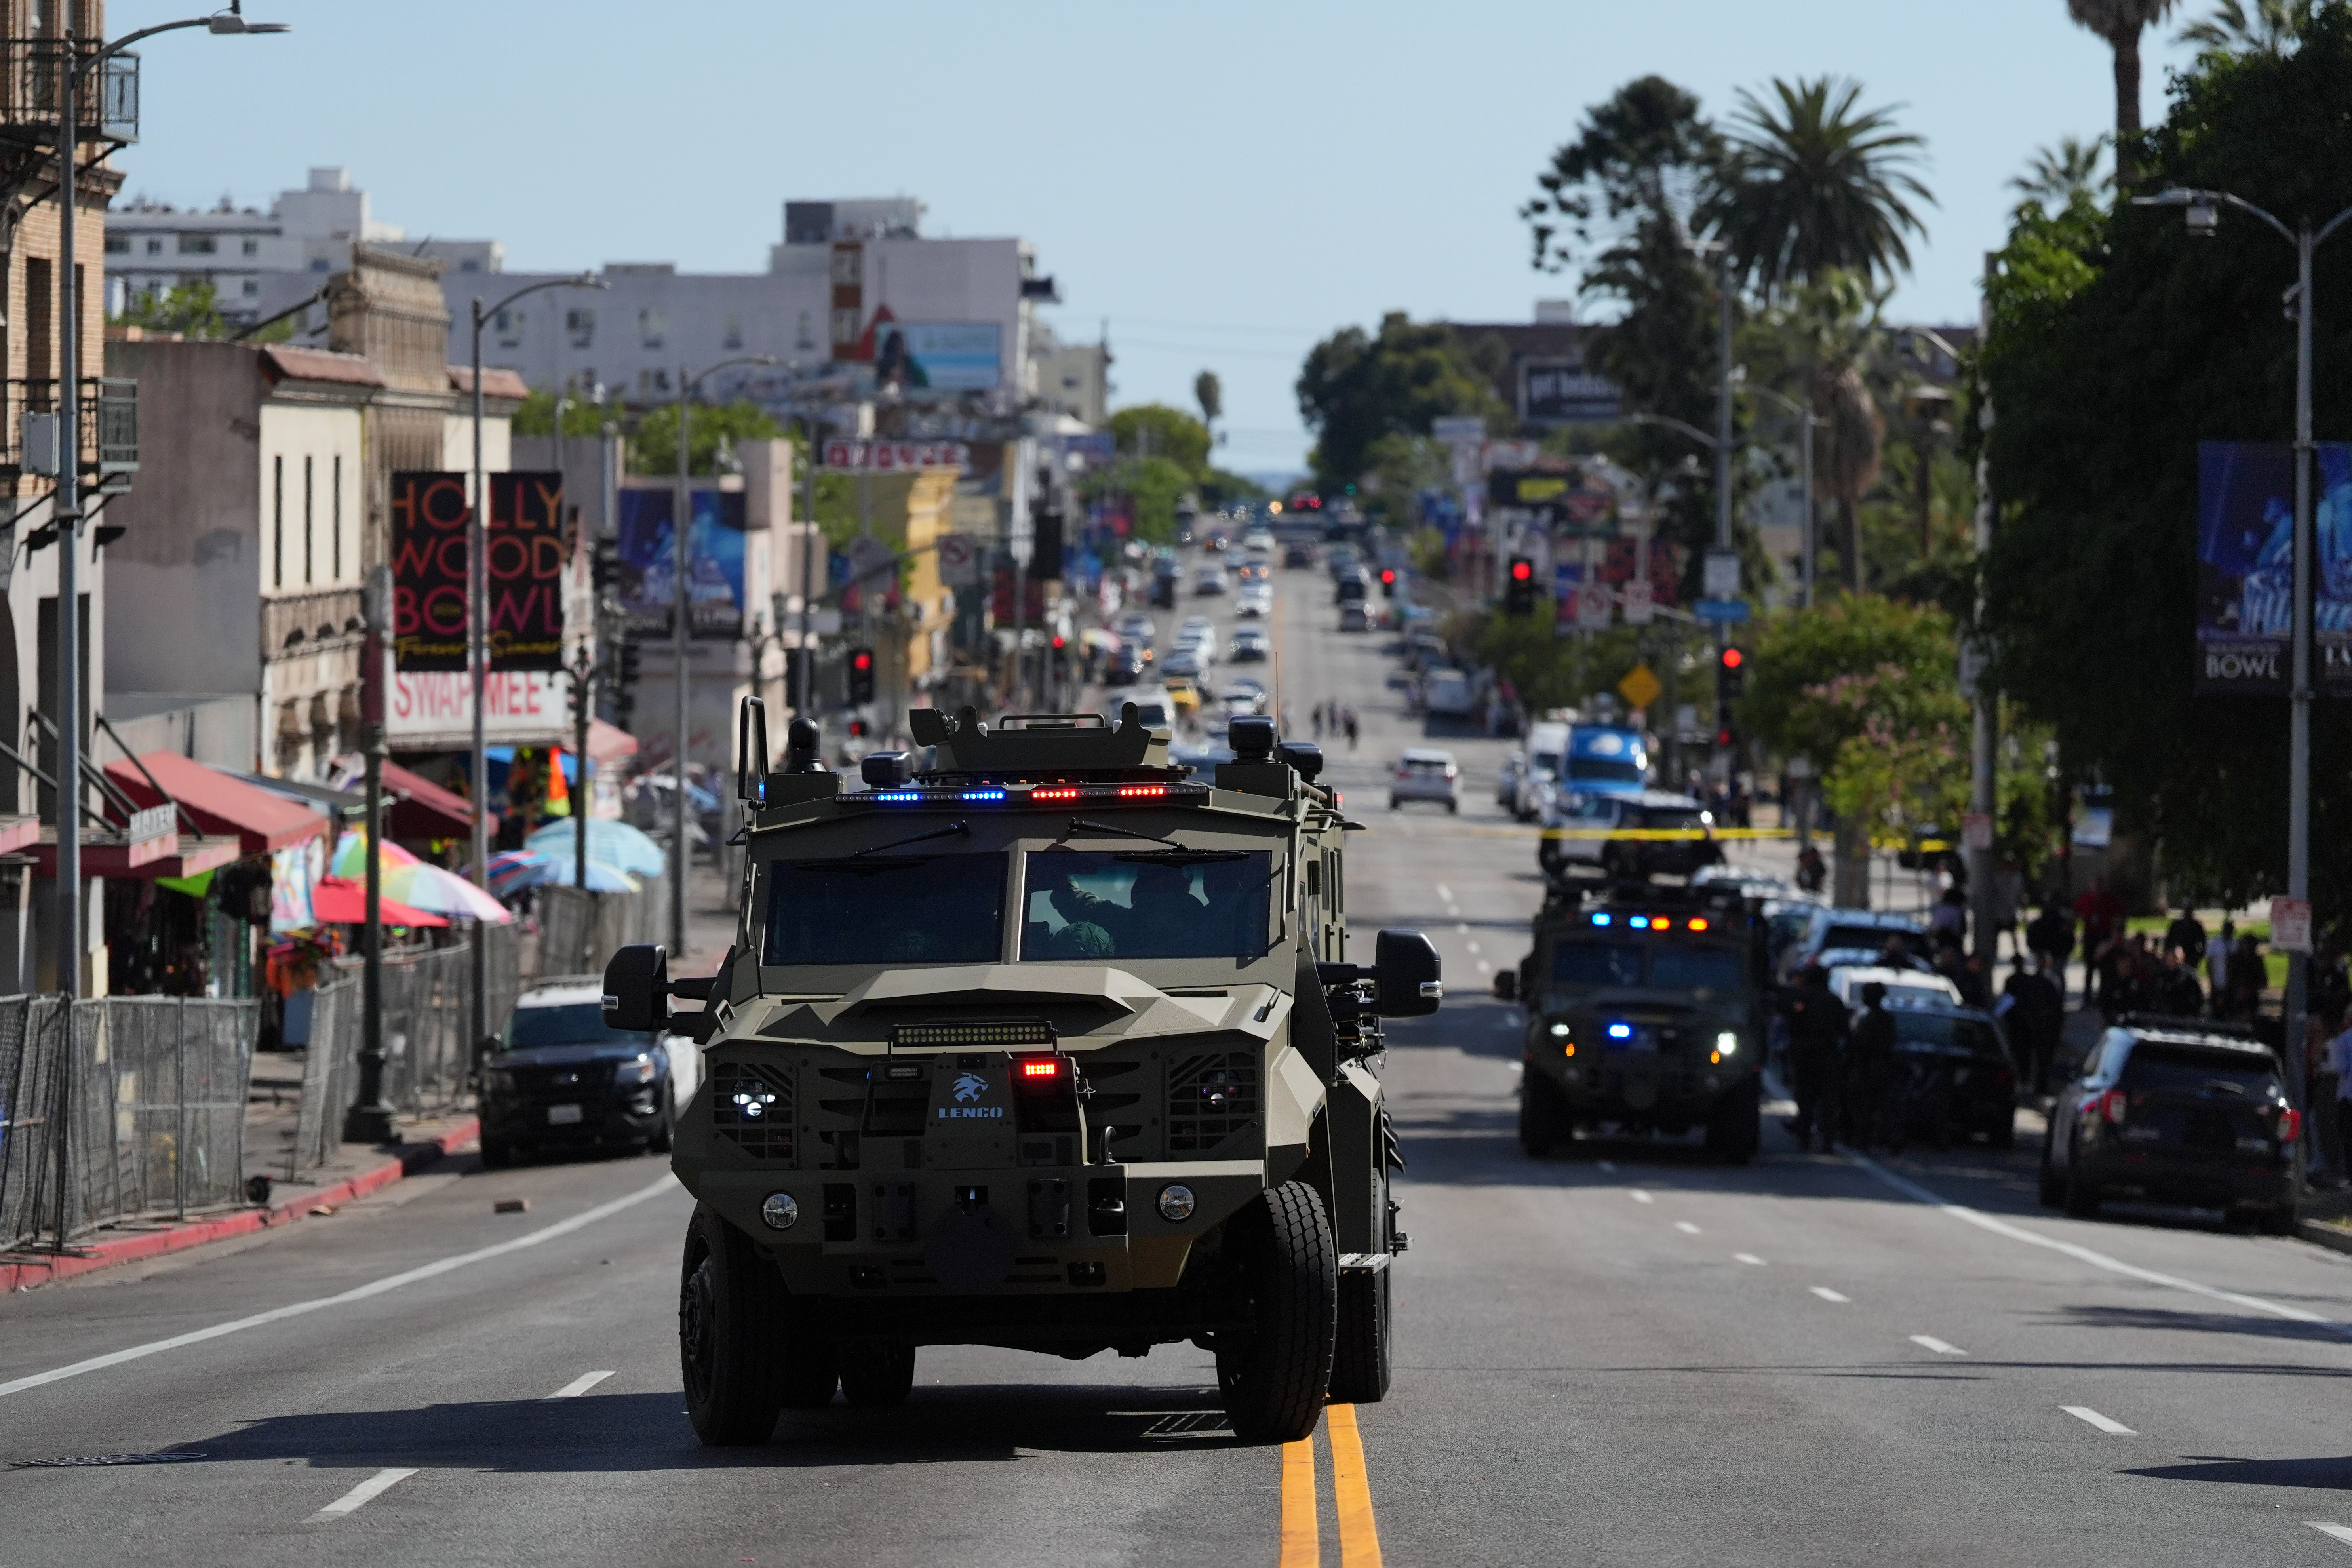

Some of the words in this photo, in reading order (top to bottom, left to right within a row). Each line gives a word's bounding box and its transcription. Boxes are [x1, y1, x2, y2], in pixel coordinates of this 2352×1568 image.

[393, 480, 563, 530] HOLLY
[393, 535, 565, 580] WOOD
[393, 585, 562, 635] BOWL
[2206, 654, 2280, 679] BOWL
[395, 672, 473, 717] SWAP
[939, 1107, 1003, 1118] LENCO
